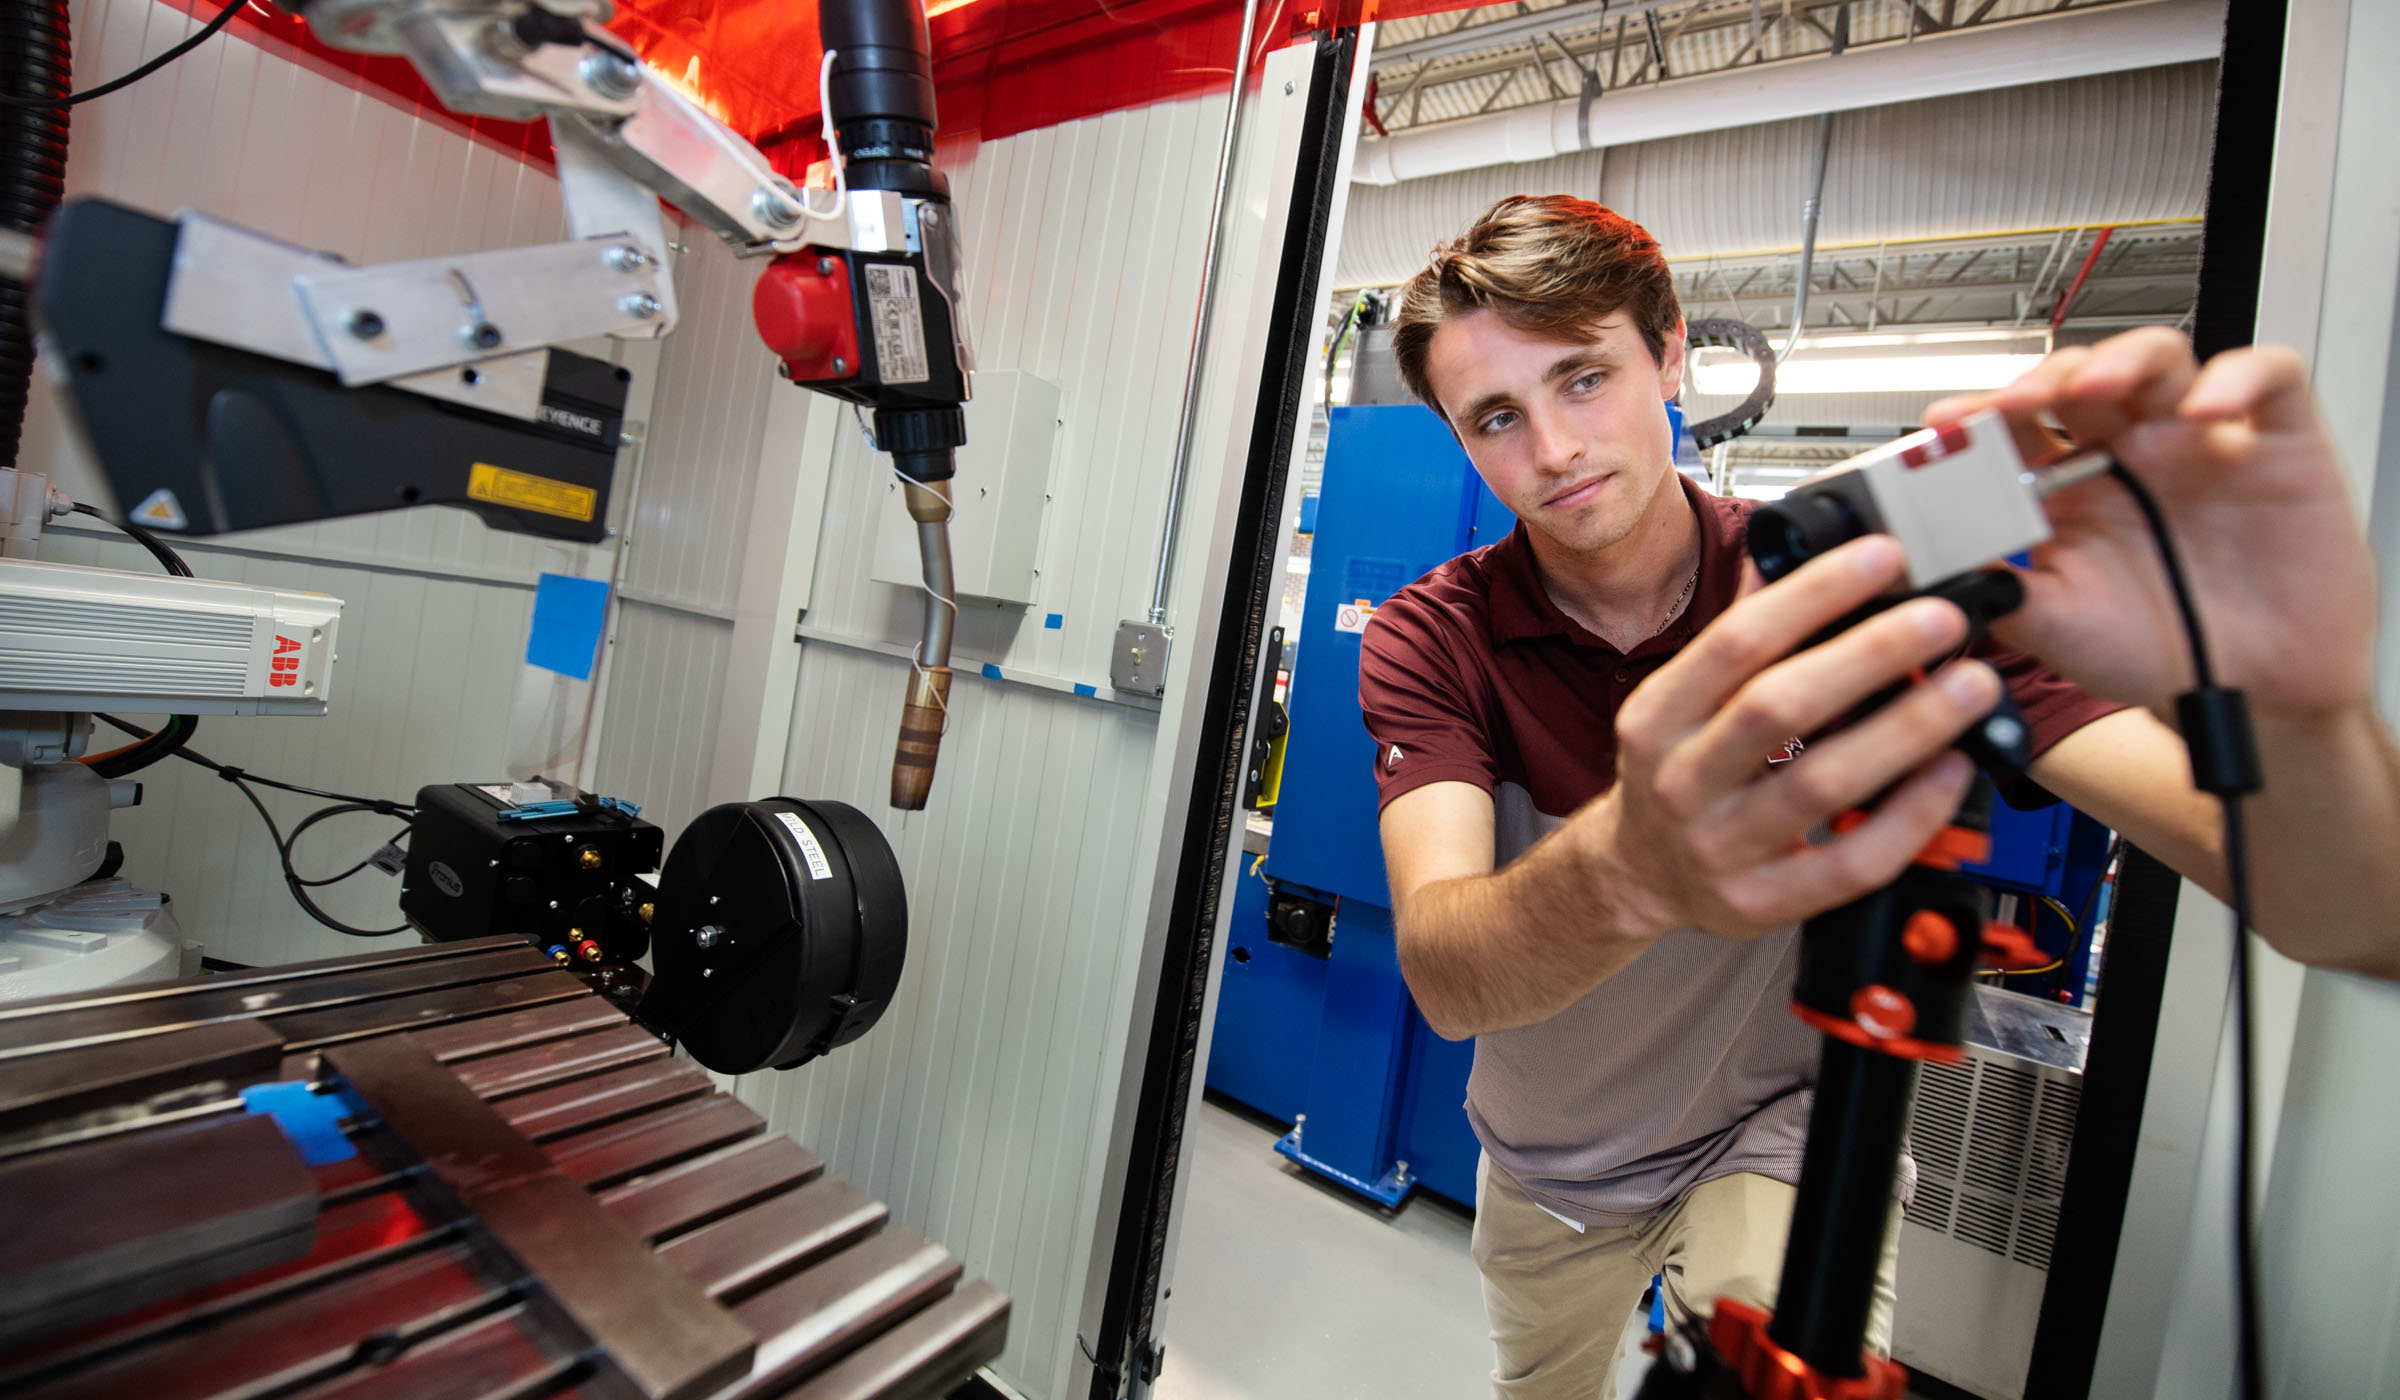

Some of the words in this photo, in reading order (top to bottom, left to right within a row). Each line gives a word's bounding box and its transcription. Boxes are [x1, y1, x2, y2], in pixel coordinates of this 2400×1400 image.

[541, 405, 602, 436] EYENCE
[269, 635, 302, 687] ABB
[802, 839, 825, 877] STEEL
